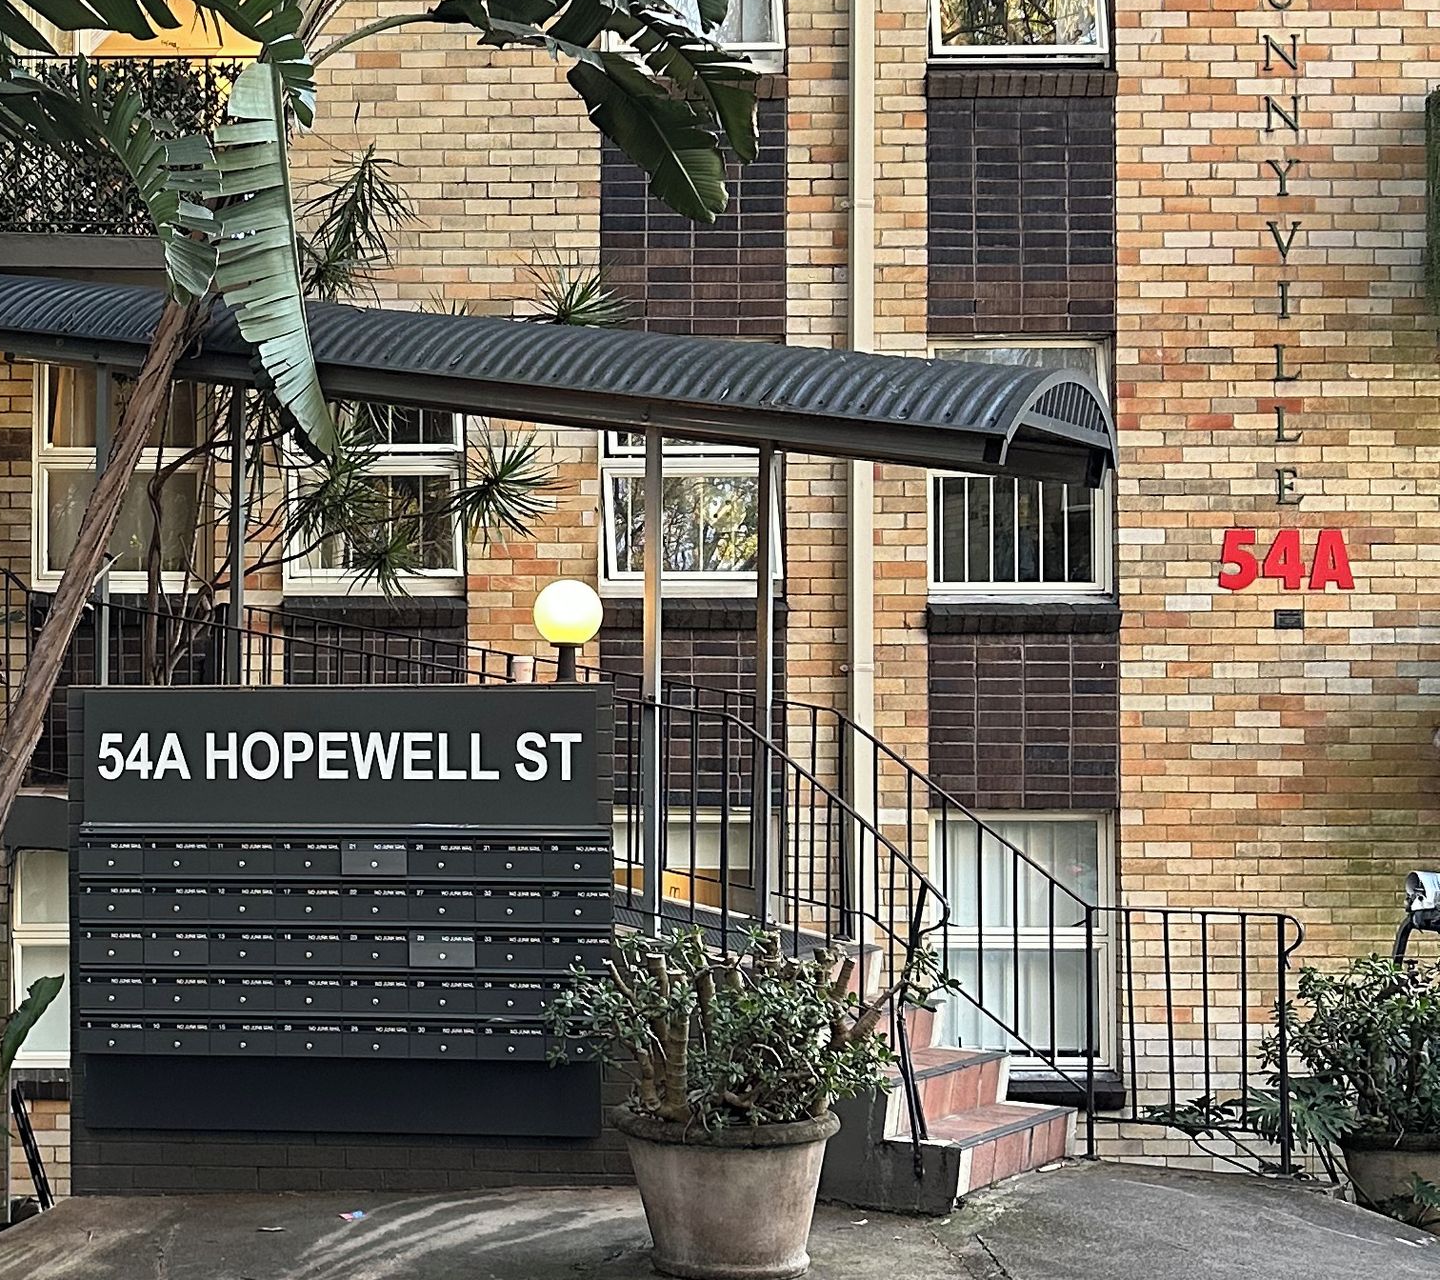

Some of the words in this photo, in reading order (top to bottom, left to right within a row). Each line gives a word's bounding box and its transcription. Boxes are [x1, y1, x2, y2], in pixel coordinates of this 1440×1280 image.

[1218, 529, 1356, 591] 54A
[97, 732, 192, 780] 54A
[206, 731, 500, 780] HOPEWELL
[514, 731, 583, 781] ST
